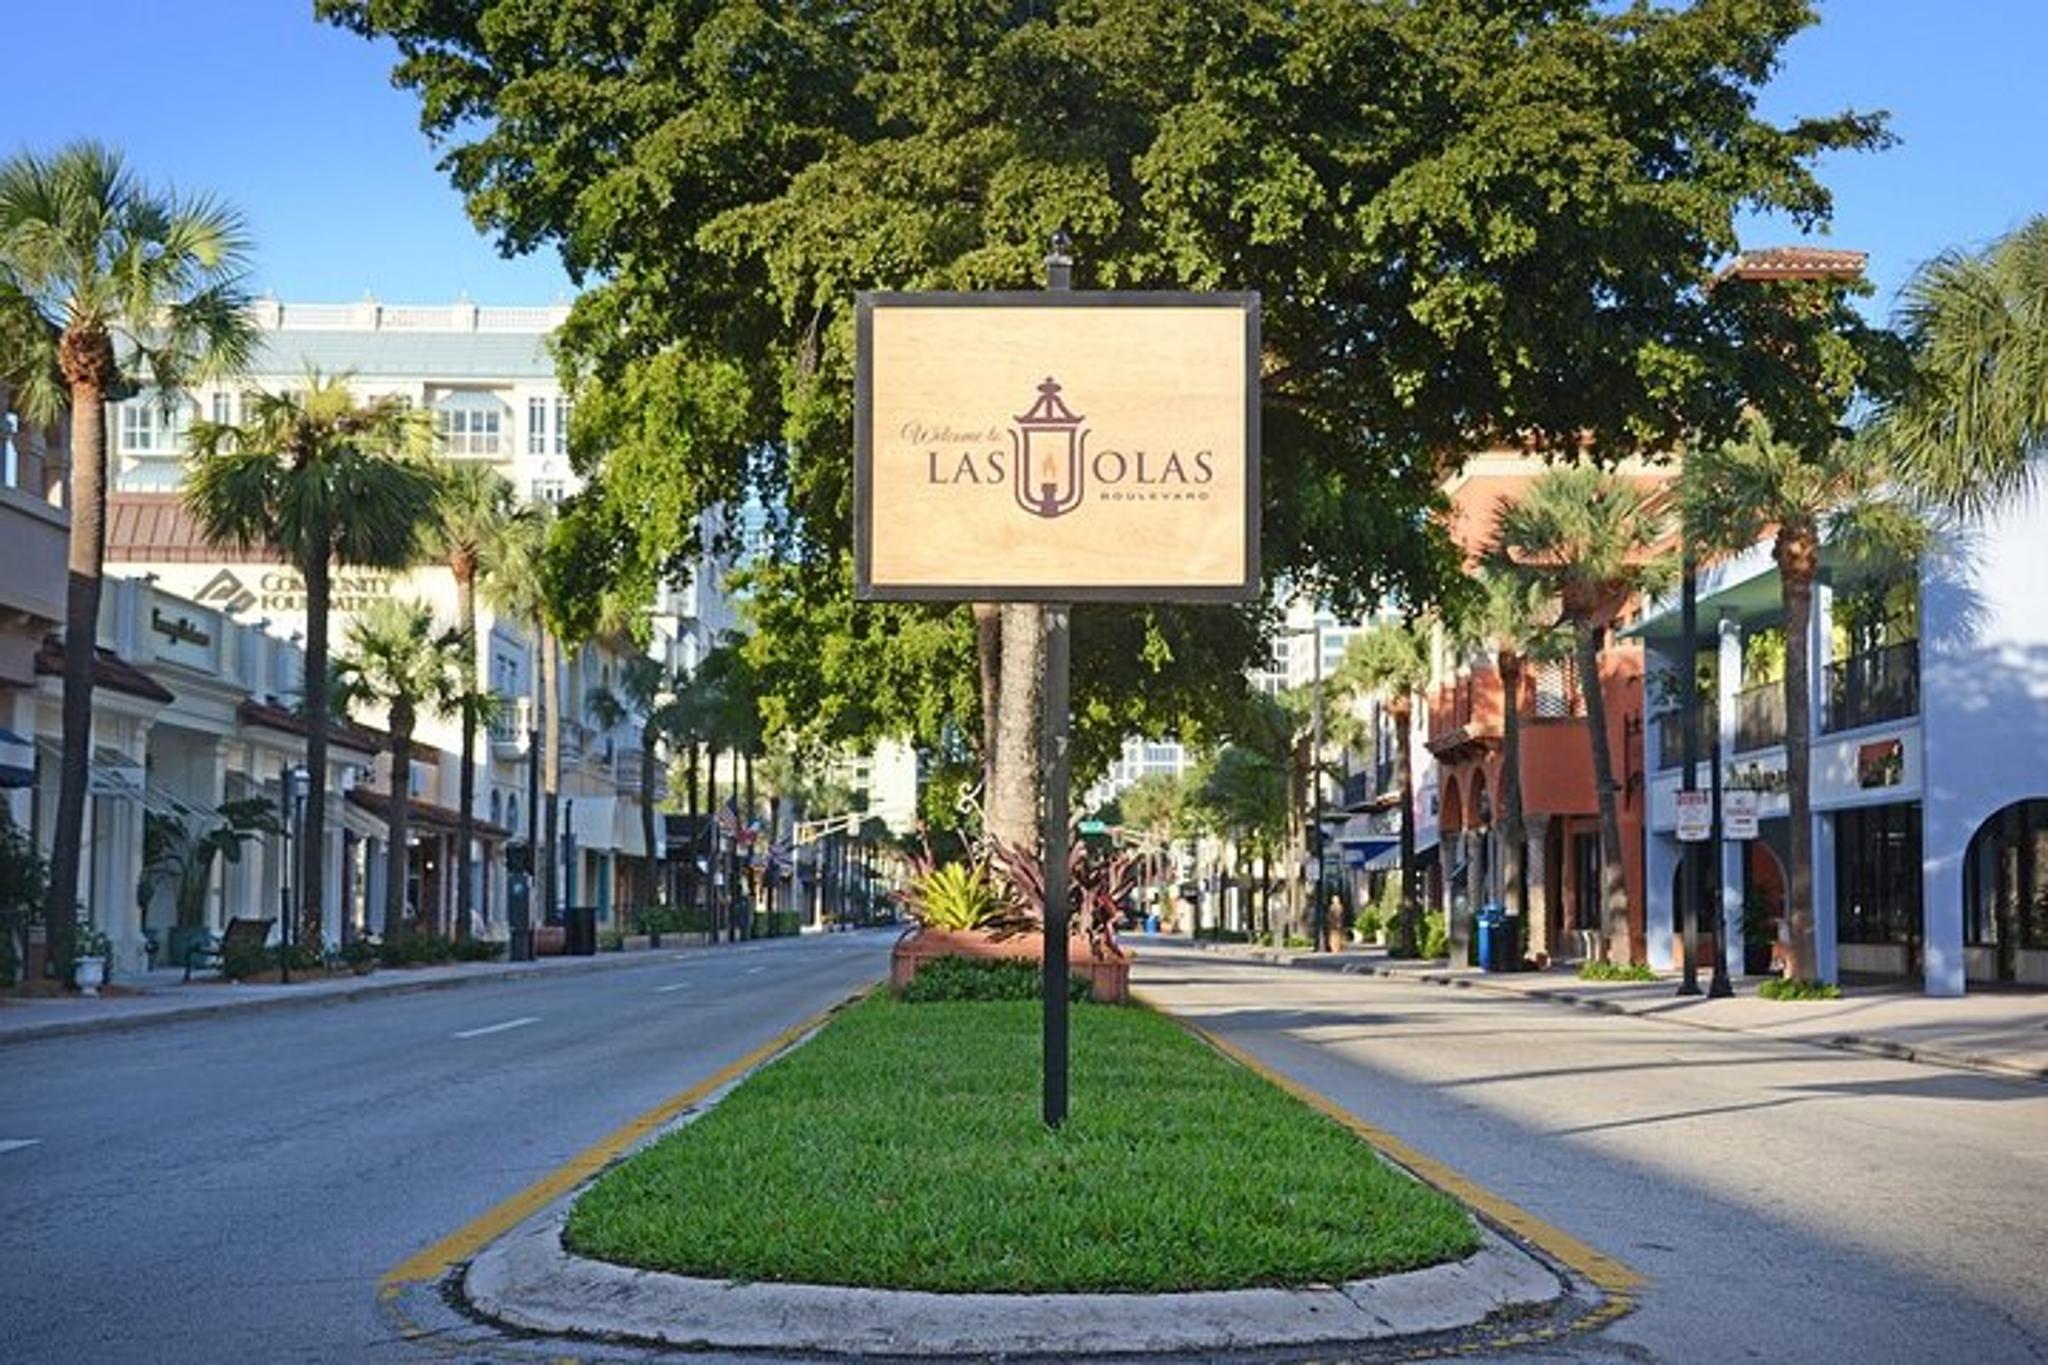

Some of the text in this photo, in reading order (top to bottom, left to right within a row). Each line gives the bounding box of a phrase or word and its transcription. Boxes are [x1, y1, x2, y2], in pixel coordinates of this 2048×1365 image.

[900, 420, 981, 445] Welcome
[929, 450, 1213, 484] LAS OLAS
[1100, 491, 1209, 501] BOULEVARD
